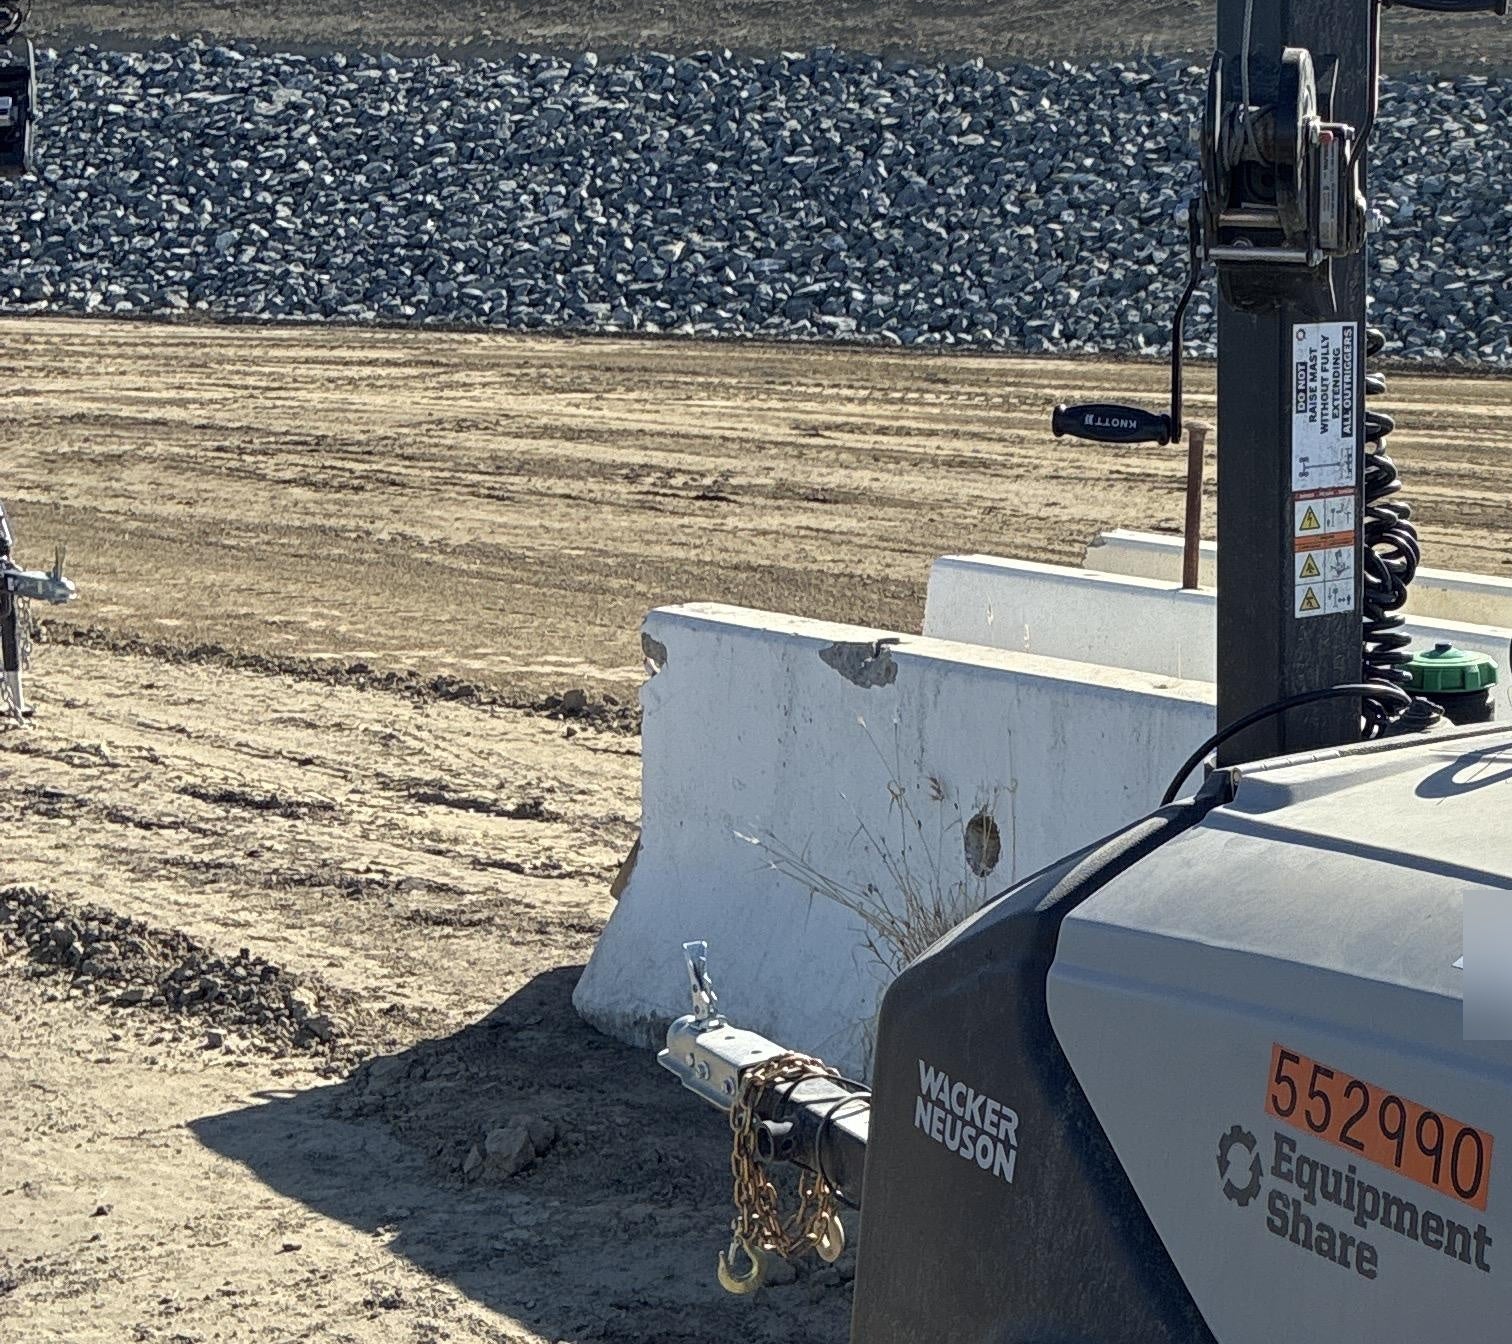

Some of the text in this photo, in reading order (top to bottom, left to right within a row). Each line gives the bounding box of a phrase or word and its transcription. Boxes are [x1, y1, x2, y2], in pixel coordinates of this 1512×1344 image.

[1094, 416, 1137, 429] KNOTT
[1296, 364, 1307, 412] DO NOT
[1308, 346, 1318, 423] RAISE MAST
[1319, 334, 1330, 435] WITHOUT FULLY
[1331, 347, 1341, 420] EXTENDING
[1342, 327, 1354, 435] ALL OUTRIGGERS
[914, 1096, 1017, 1185] NEUSON
[917, 1058, 1020, 1141] WACKER
[1270, 1048, 1486, 1202] 552990
[1265, 1187, 1379, 1281] Share
[1271, 1129, 1494, 1273] Equipment
